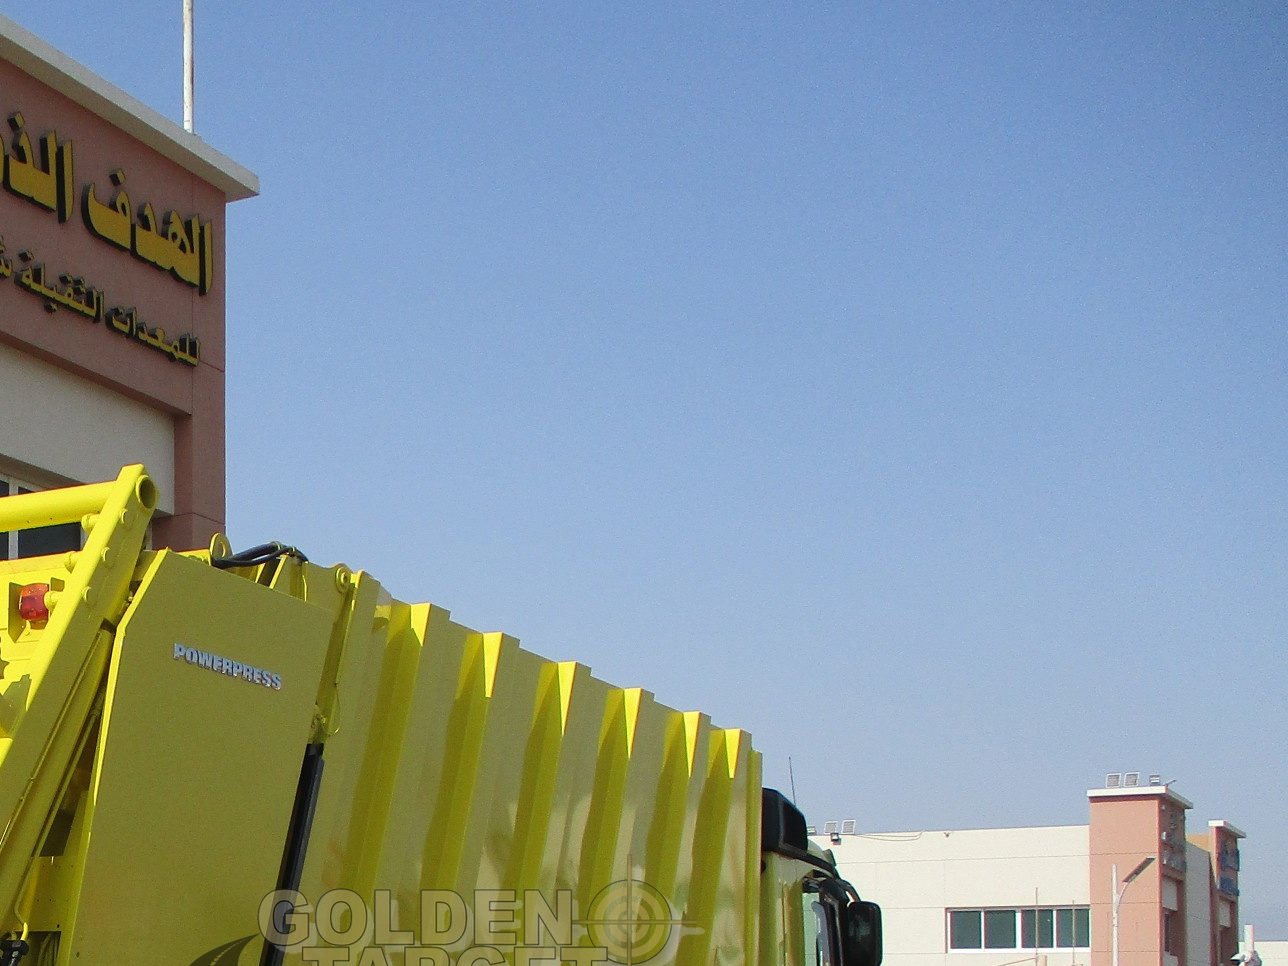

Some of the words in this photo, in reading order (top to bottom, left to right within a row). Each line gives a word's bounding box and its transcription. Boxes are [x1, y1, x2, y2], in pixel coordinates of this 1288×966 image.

[82, 168, 213, 296] الهدف
[14, 250, 104, 323] الثقيلة
[105, 306, 200, 367] للمعدات
[174, 643, 282, 691] POWERPRESS
